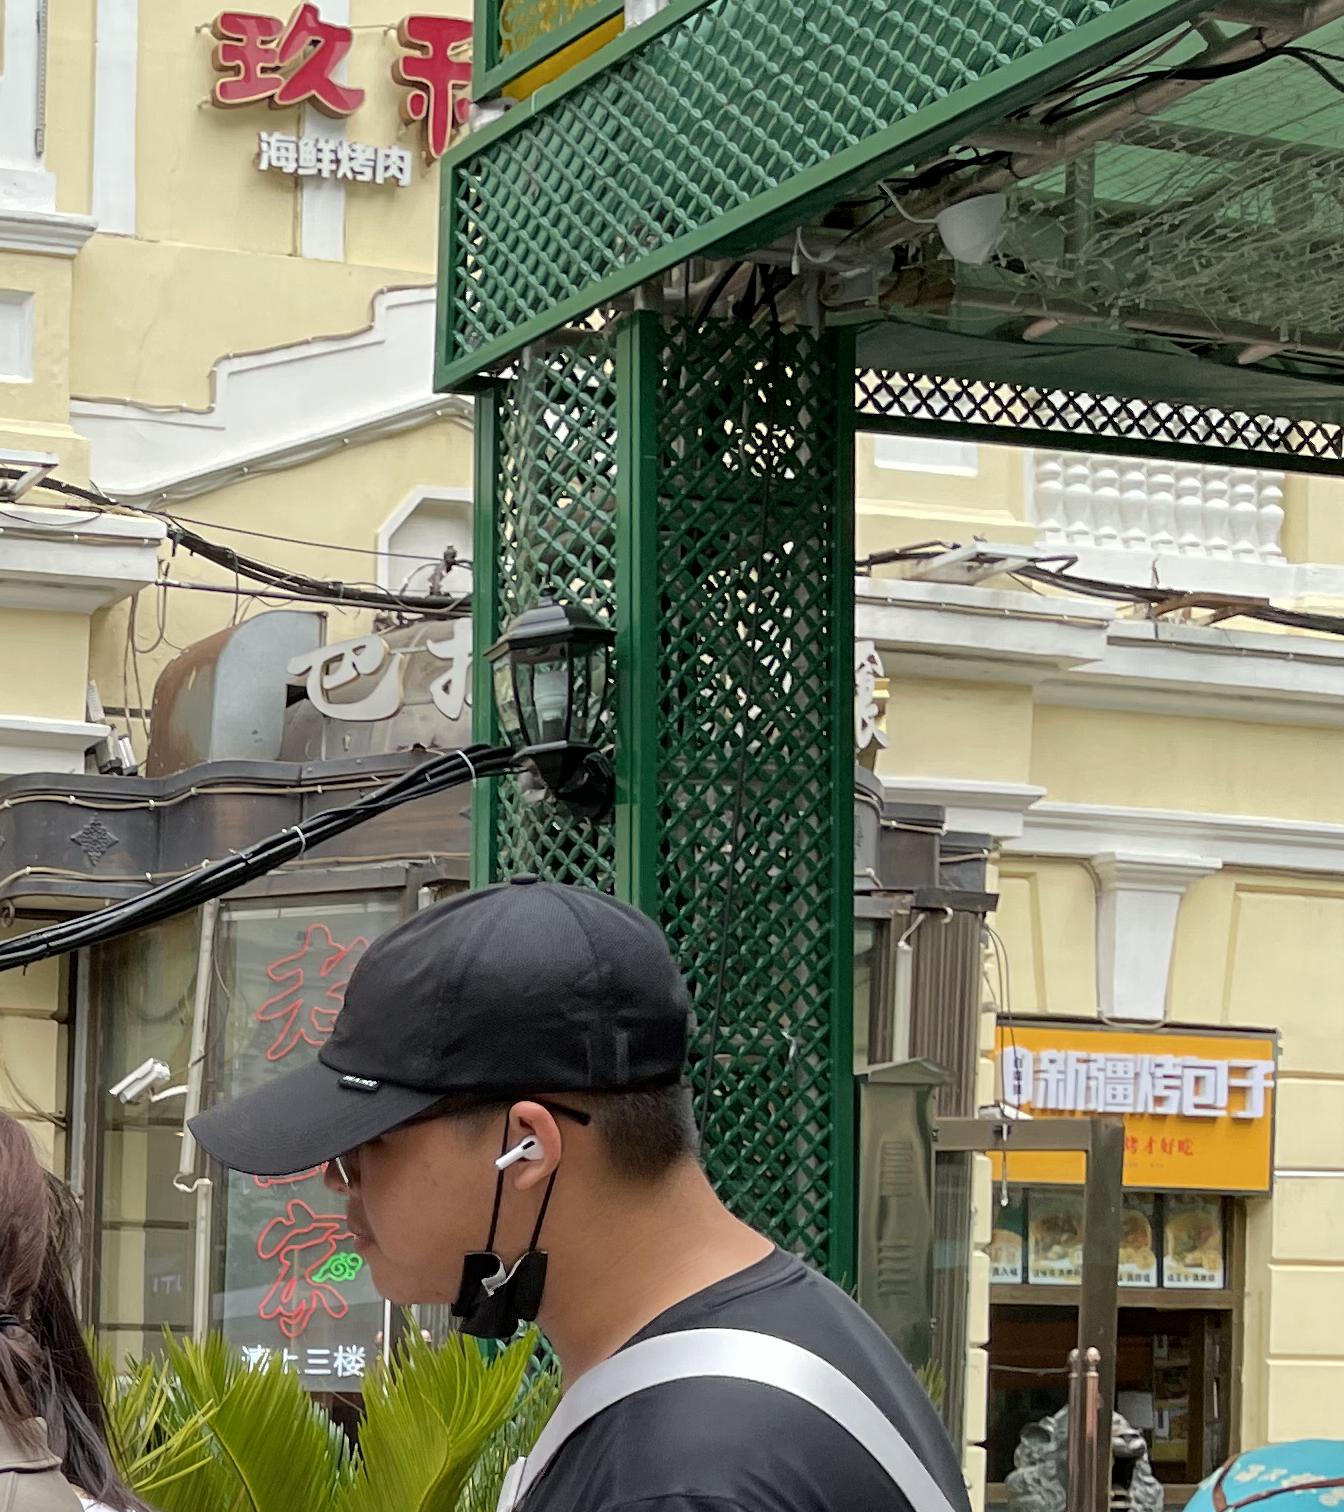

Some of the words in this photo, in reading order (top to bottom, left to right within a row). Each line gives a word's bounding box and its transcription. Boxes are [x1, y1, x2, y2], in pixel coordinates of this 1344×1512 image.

[258, 131, 413, 187] 海鲜烤肉
[1031, 1048, 1275, 1119] 新疆烤包子
